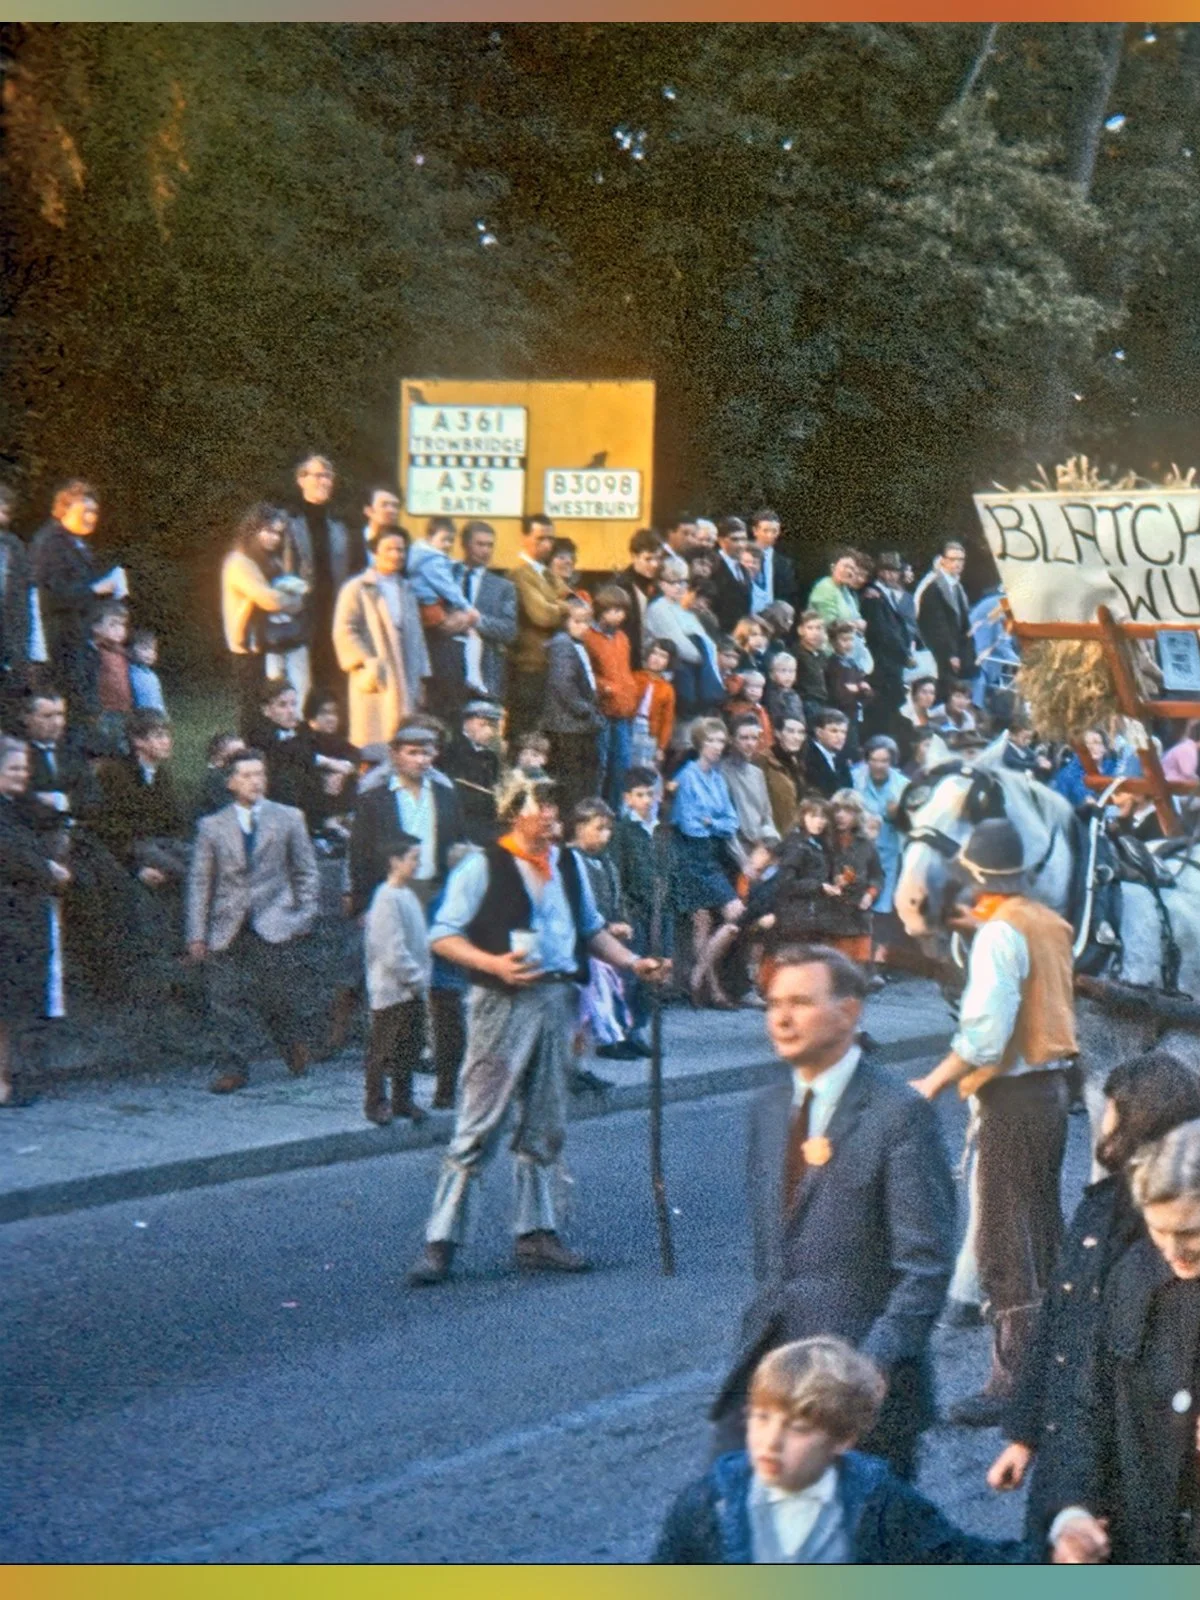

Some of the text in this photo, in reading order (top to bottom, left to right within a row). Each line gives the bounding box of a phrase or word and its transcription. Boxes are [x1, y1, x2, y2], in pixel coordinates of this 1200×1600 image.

[431, 410, 504, 433] A361
[413, 436, 523, 454] TROWBRIDGE
[437, 471, 495, 492] A36
[552, 474, 633, 496] B3098
[441, 496, 491, 512] BATH
[548, 500, 637, 516] WESTBURY
